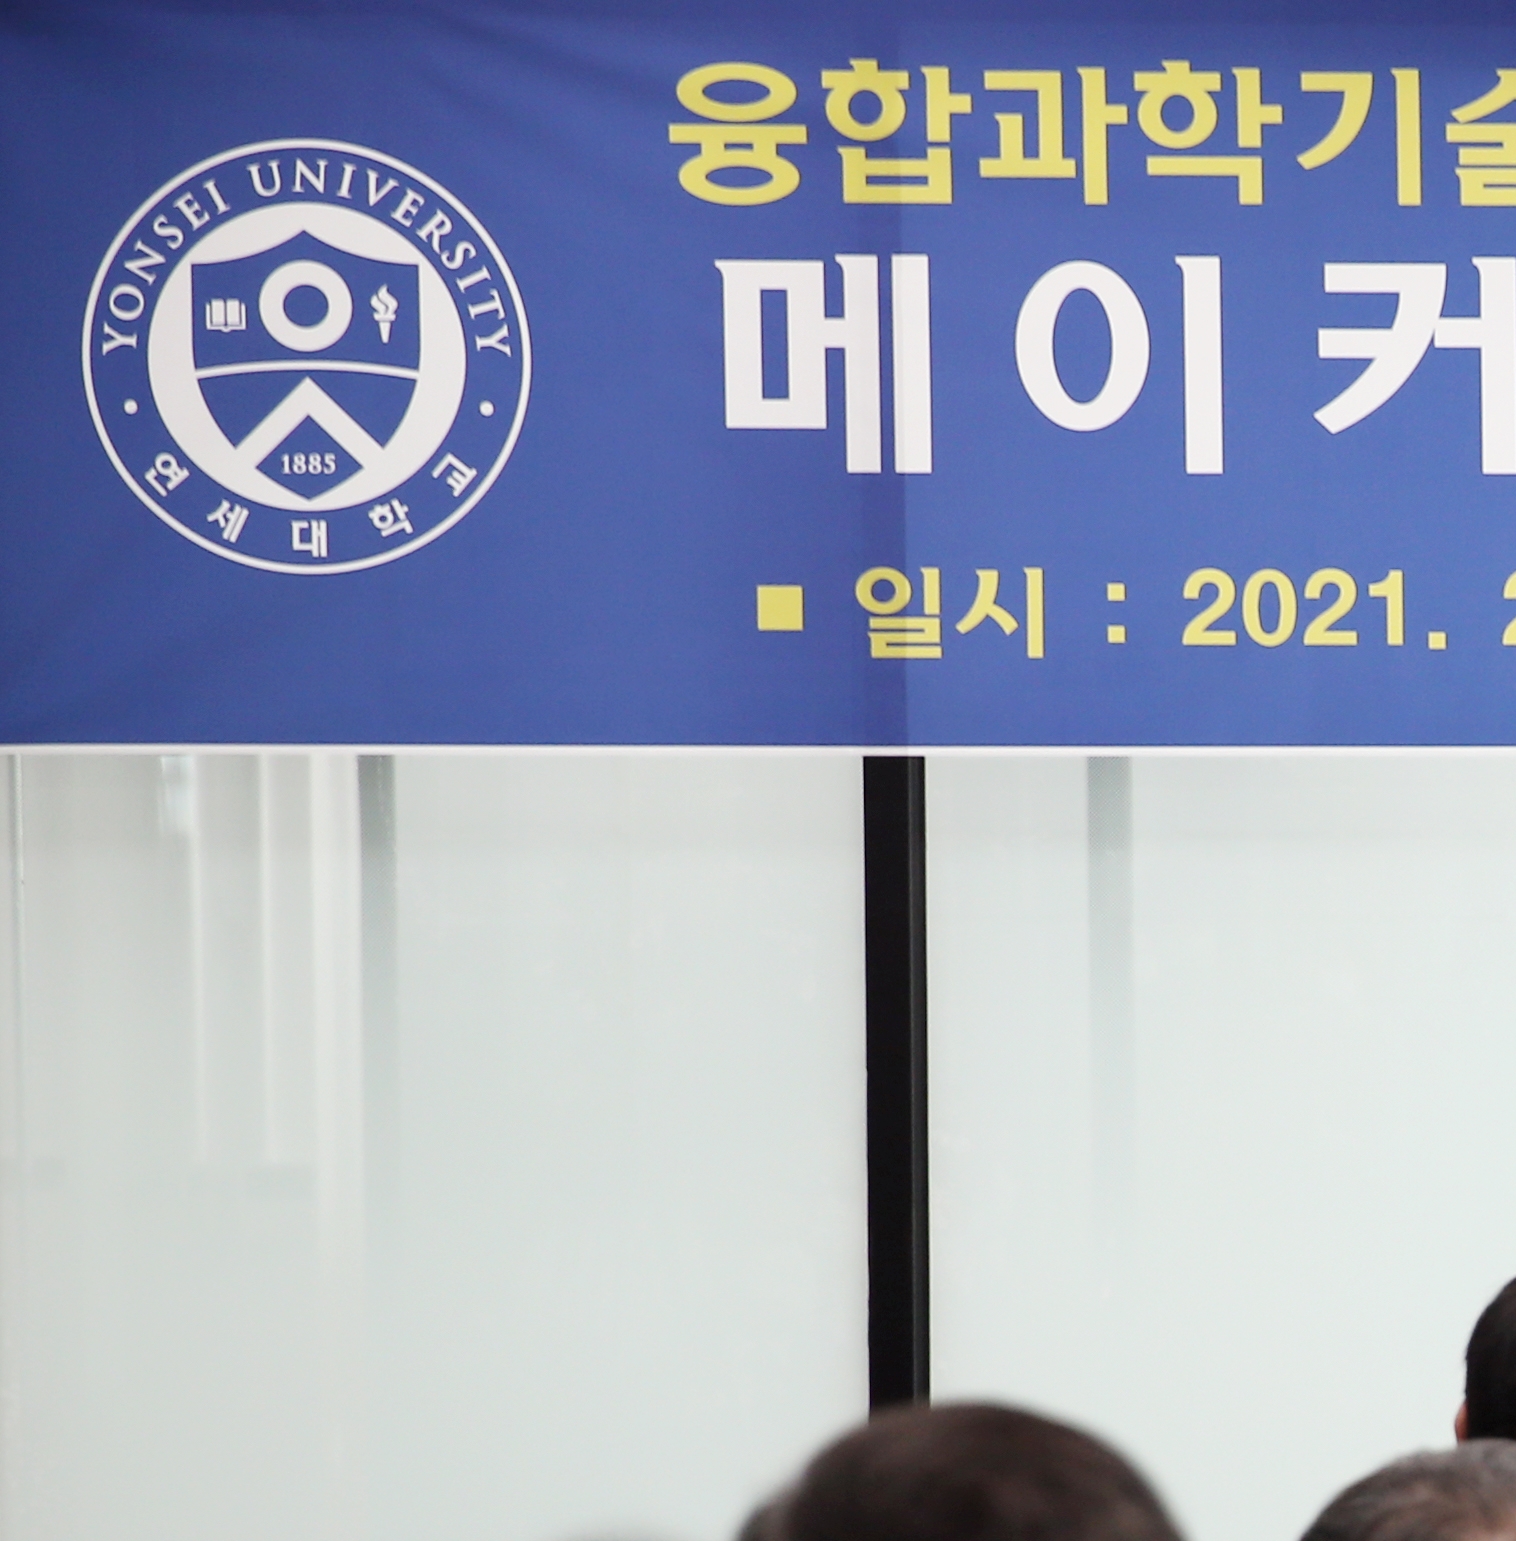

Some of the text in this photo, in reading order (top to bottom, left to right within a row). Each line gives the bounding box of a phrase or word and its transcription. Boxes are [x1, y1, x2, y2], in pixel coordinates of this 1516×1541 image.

[102, 158, 512, 358] YONSEI UNIVERSITY
[144, 452, 479, 559] 연세대학교
[281, 453, 337, 475] 1885
[854, 566, 1046, 660] 일시
[1181, 567, 1448, 651] 2021.
